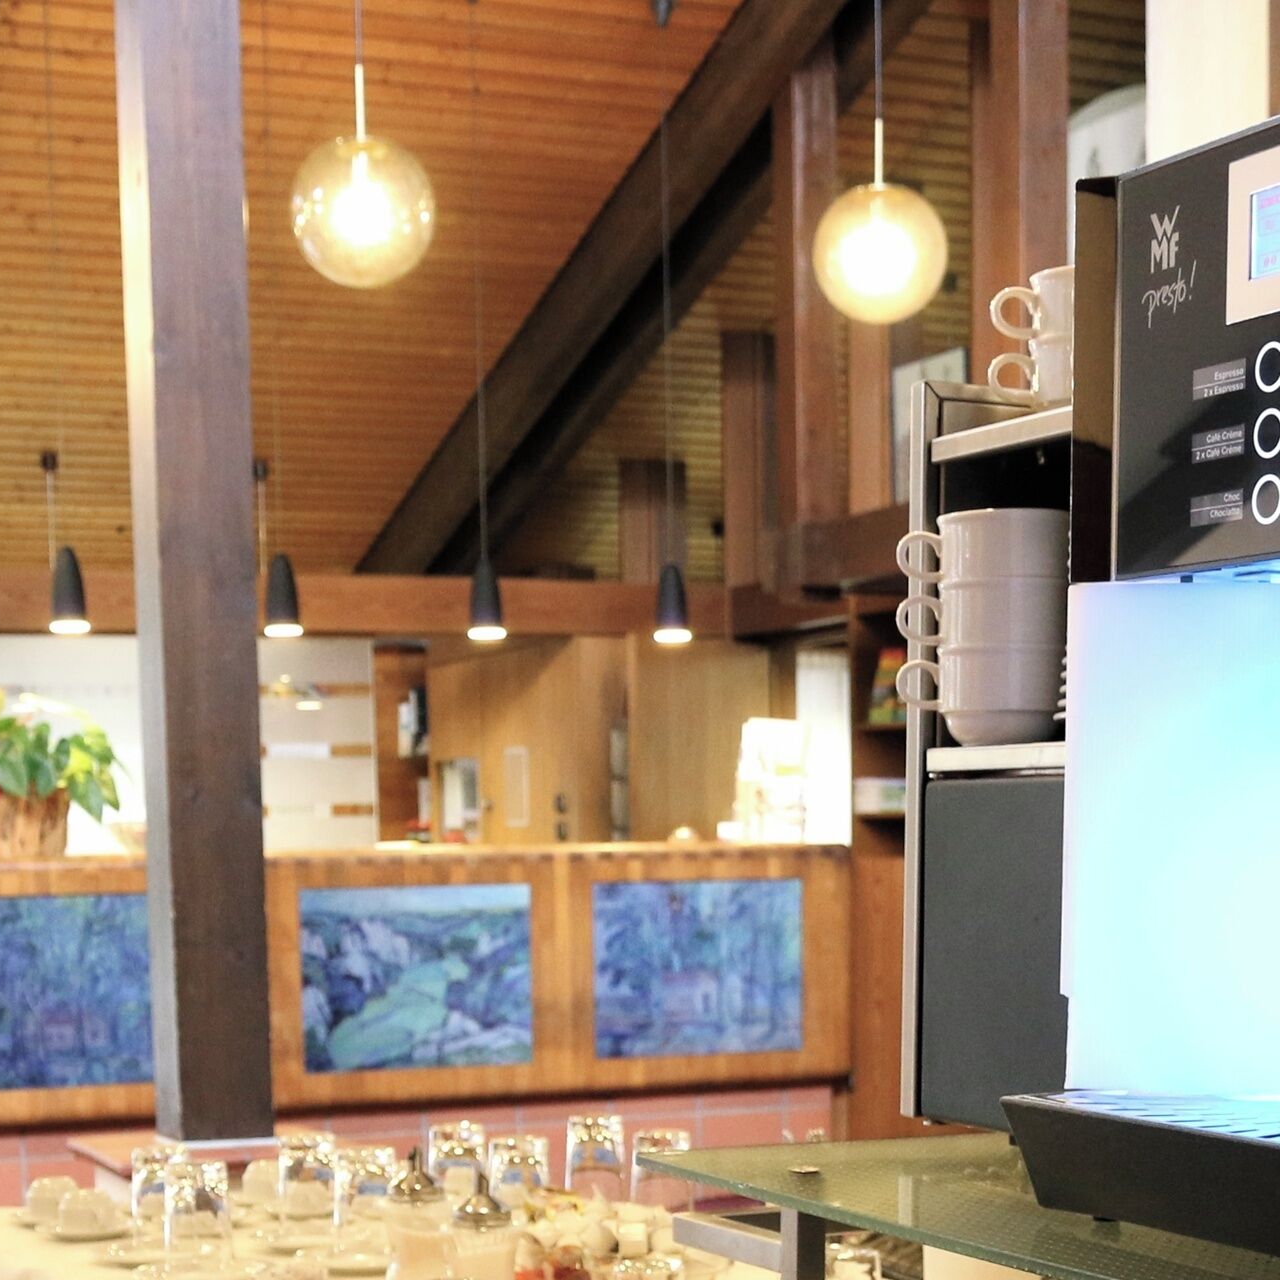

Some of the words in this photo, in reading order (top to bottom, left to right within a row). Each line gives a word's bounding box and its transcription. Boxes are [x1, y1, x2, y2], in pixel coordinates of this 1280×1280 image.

[1142, 259, 1196, 329] presto!
[1214, 367, 1244, 381] Espresso
[1214, 382, 1244, 396] Espresso
[1206, 432, 1221, 444] Café
[1206, 447, 1221, 459] Café
[1223, 492, 1240, 503] Choc
